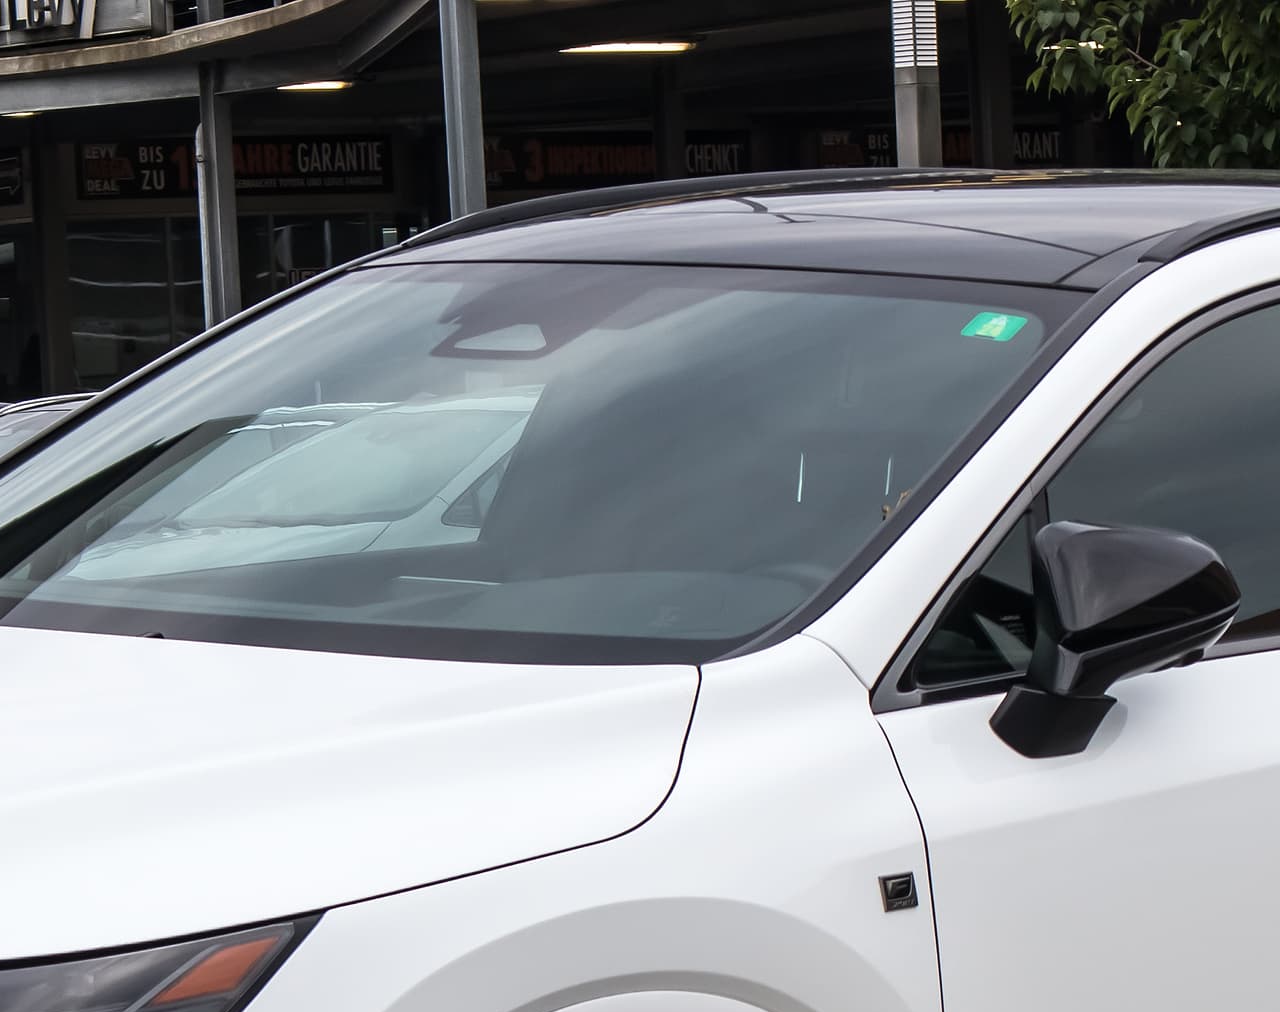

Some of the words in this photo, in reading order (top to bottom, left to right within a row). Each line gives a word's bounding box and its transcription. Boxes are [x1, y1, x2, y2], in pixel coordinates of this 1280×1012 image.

[138, 145, 165, 164] BIS
[233, 142, 294, 176] AHRE
[296, 141, 384, 173] GARANTIE
[685, 144, 740, 175] CHENKT
[1014, 131, 1062, 161] ARANT
[140, 169, 168, 192] ZU
